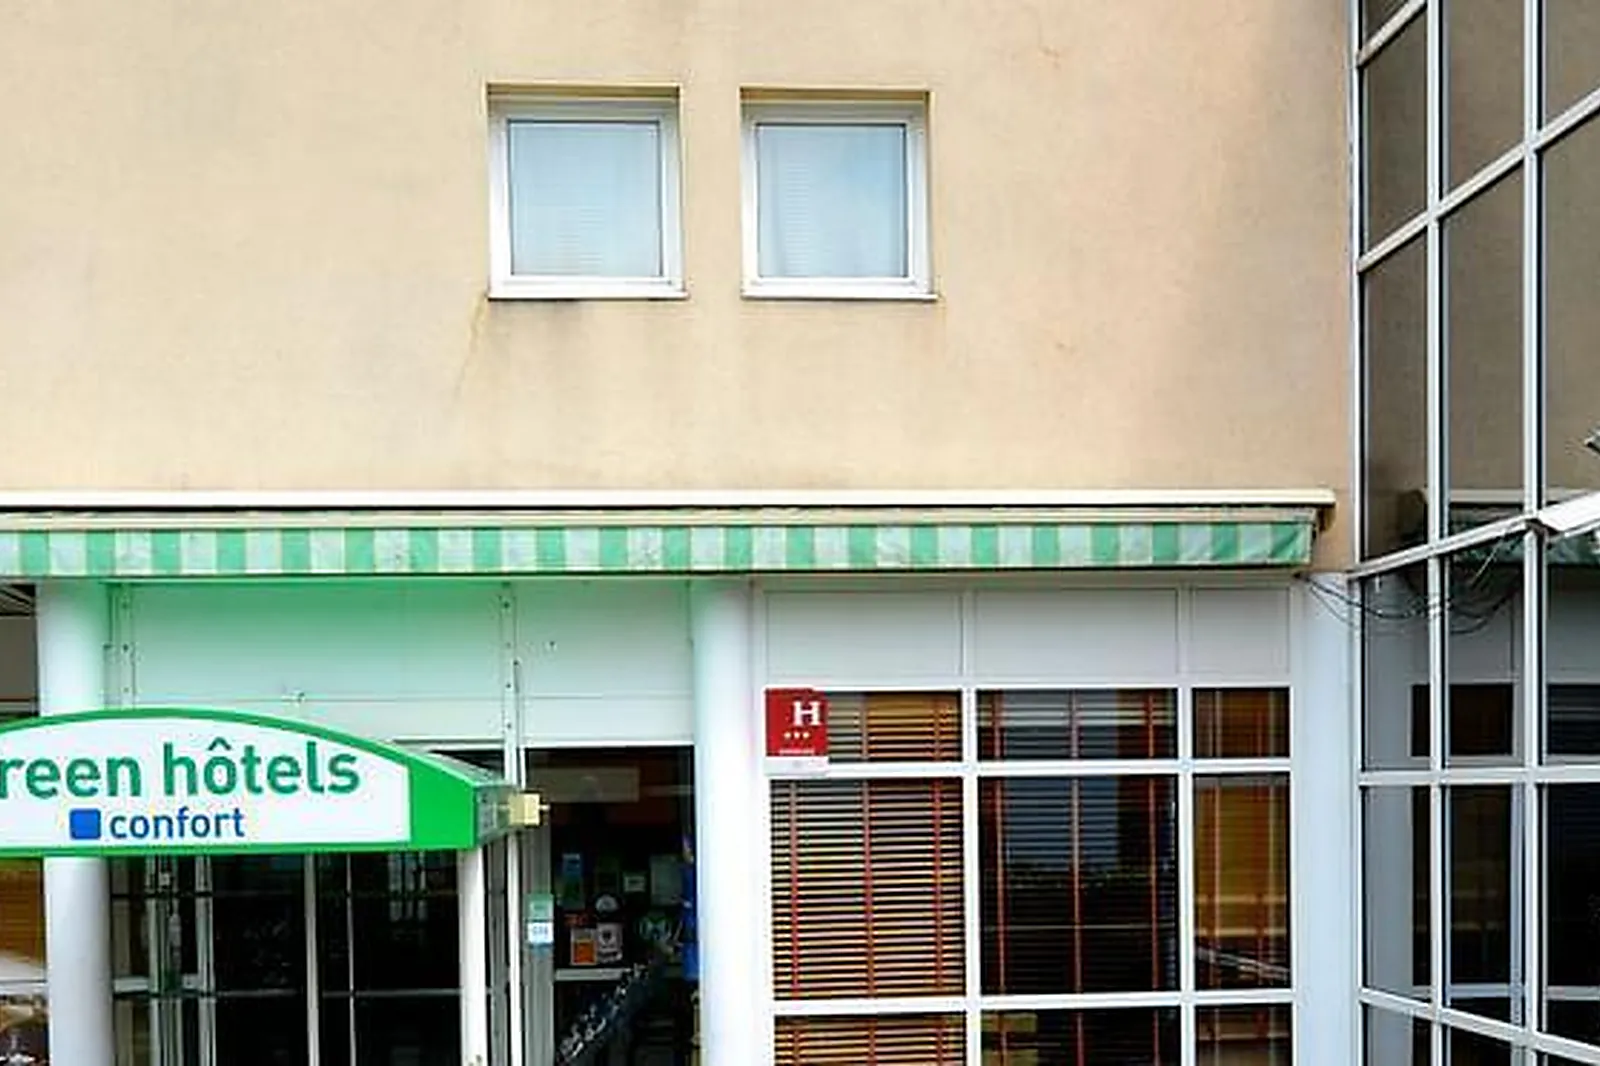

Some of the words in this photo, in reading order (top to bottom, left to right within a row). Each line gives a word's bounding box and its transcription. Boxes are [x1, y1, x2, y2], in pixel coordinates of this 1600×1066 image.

[793, 701, 820, 726] H
[0, 757, 141, 799] reen
[163, 737, 360, 796] hôtels
[109, 806, 245, 839] confort
